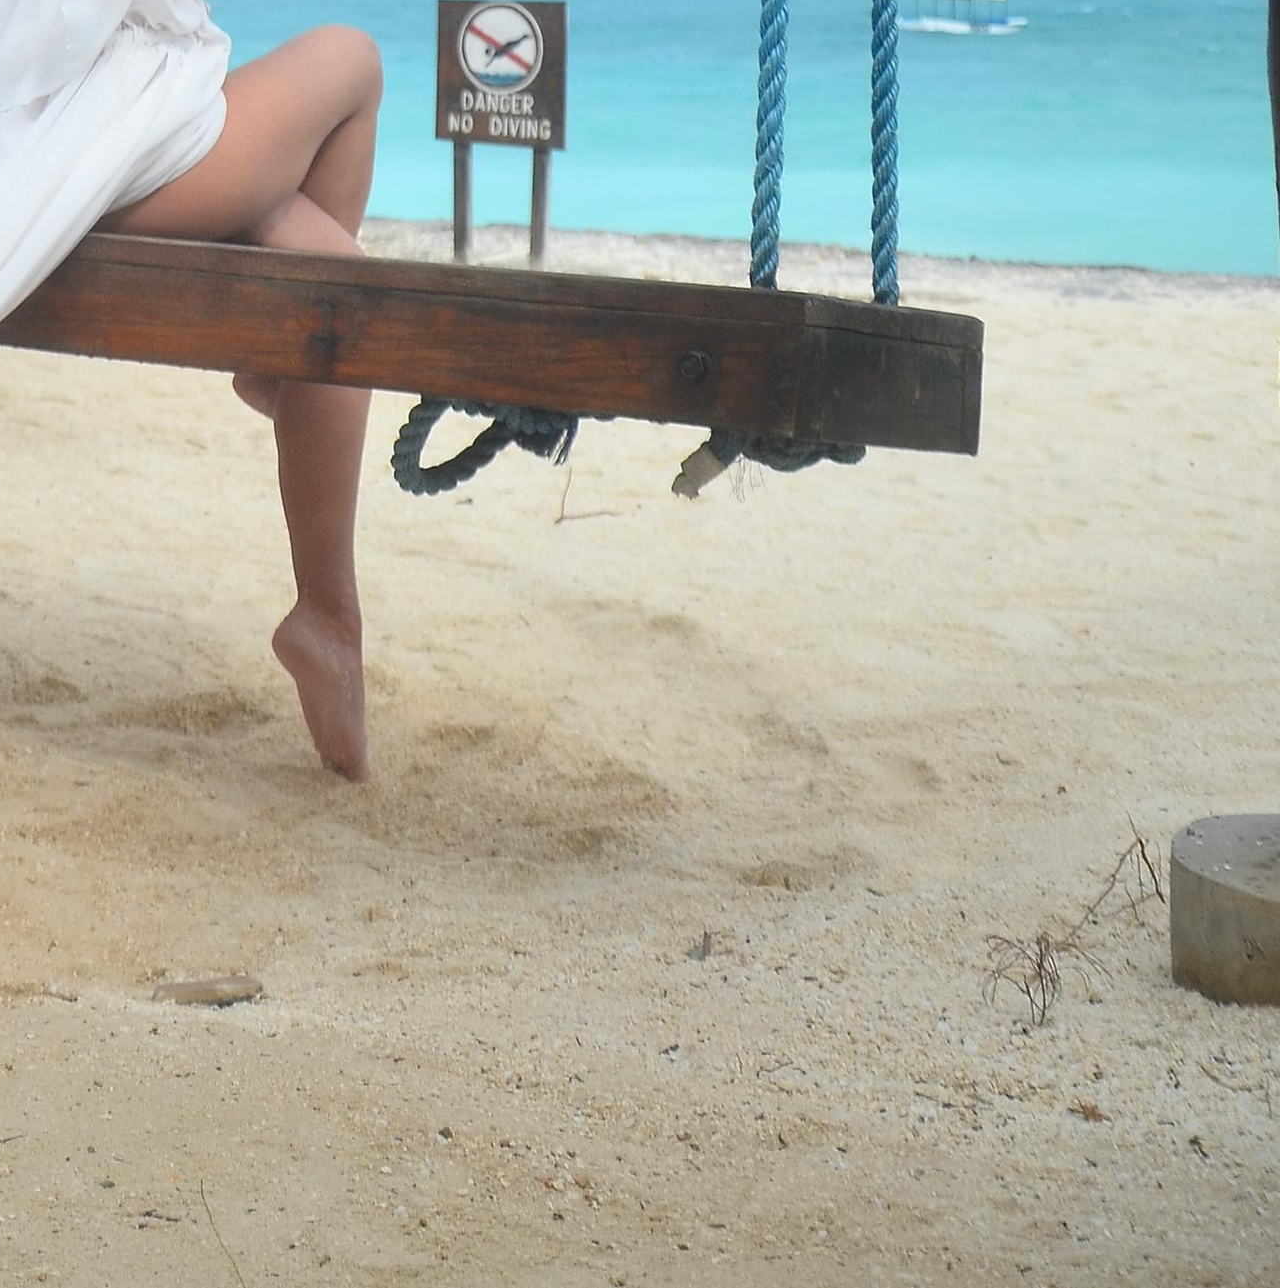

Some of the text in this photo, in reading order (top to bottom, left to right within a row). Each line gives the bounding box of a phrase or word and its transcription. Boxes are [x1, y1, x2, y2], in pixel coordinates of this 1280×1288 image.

[462, 90, 534, 115] DANGER
[449, 112, 551, 140] NO DIVING
